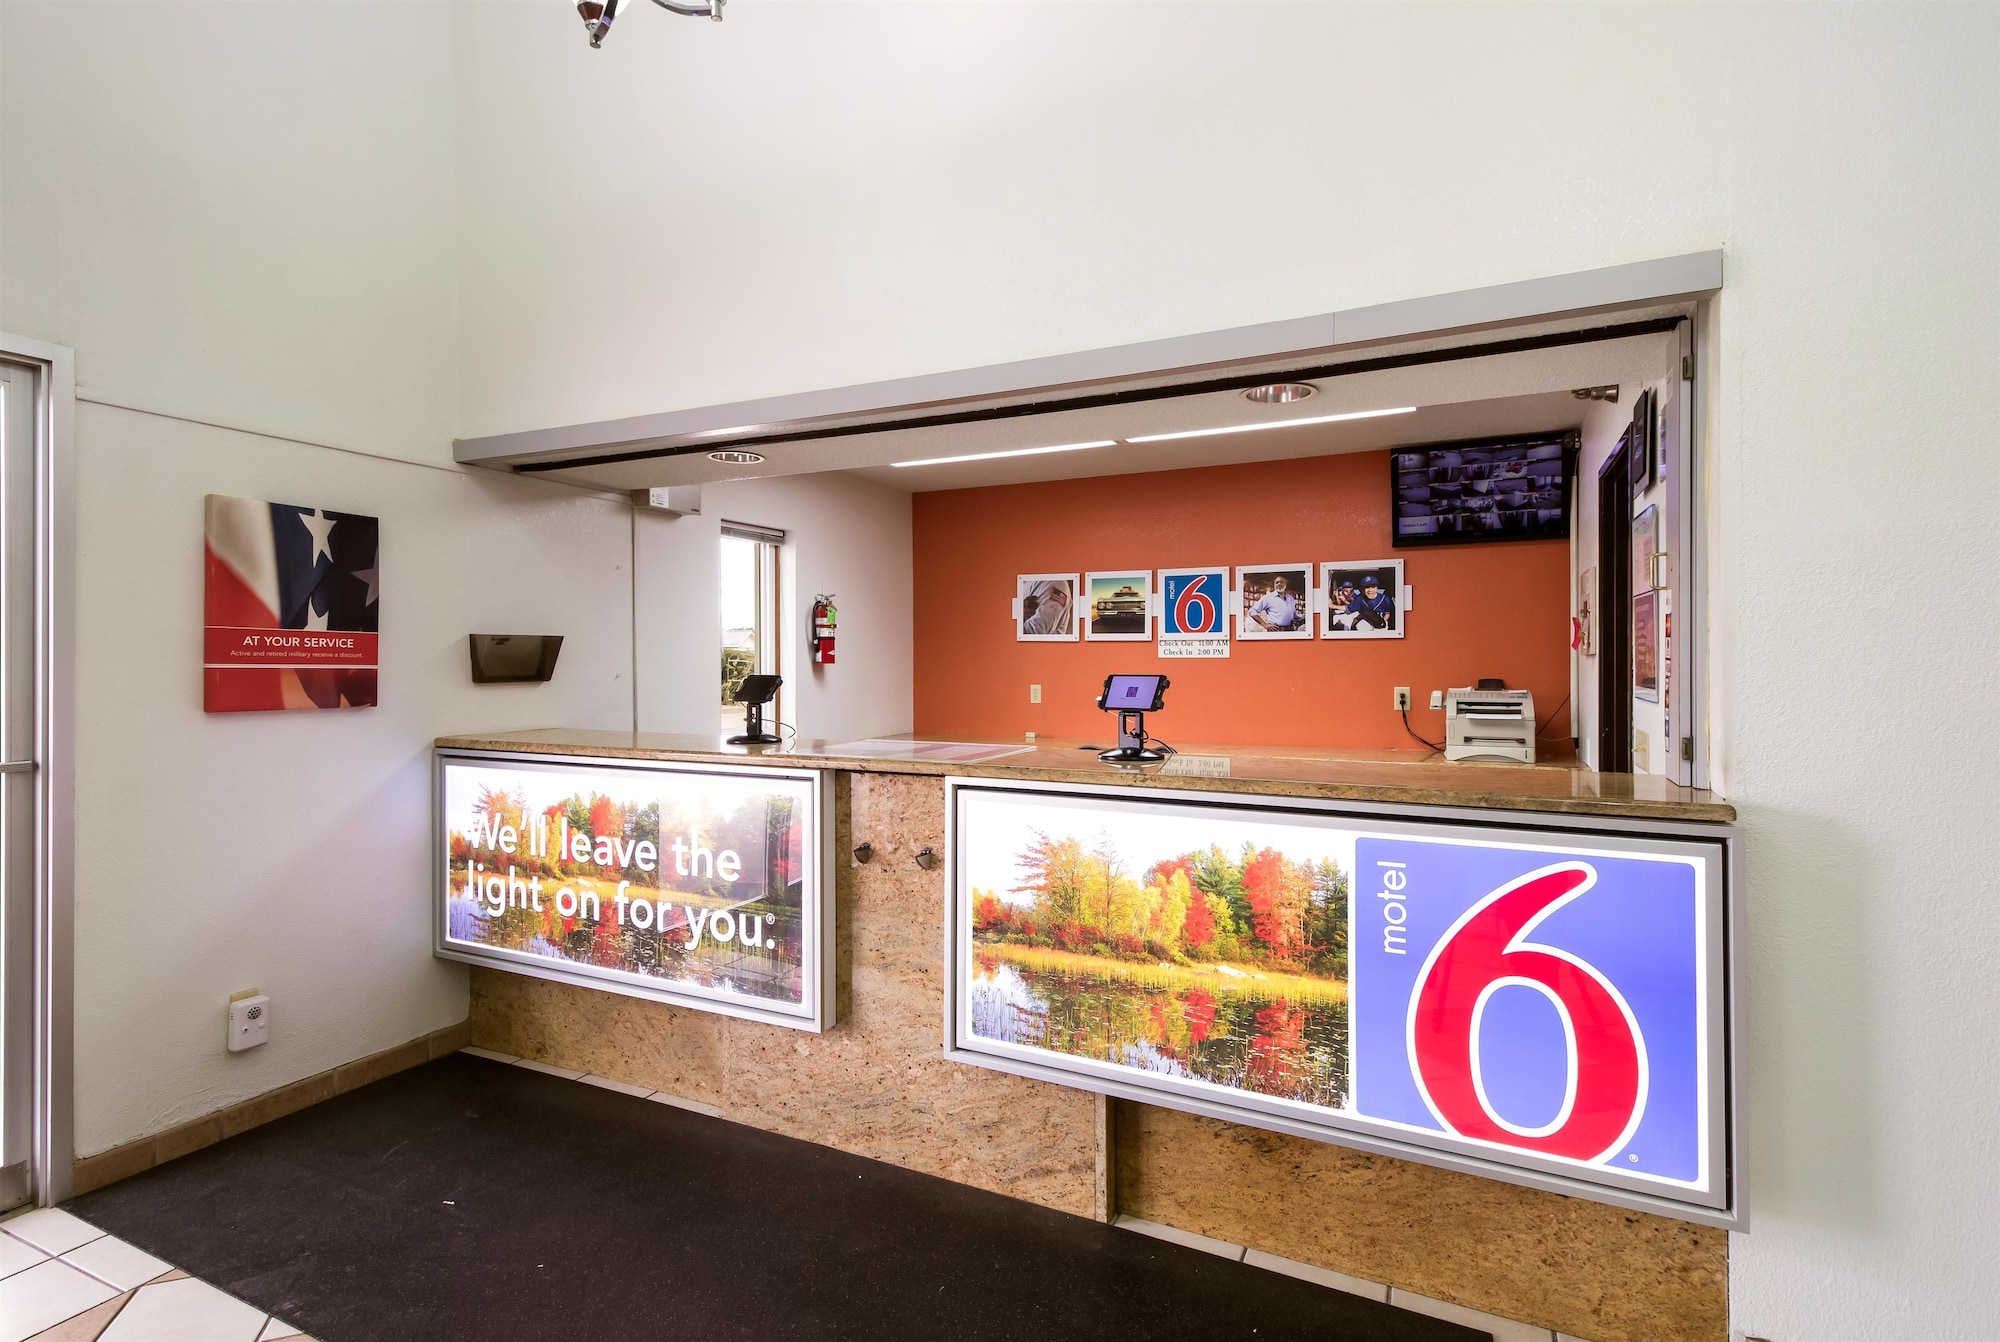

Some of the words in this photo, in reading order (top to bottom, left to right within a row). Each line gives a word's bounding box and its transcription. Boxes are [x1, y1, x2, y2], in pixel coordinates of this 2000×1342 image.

[1174, 575, 1216, 634] 6
[230, 649, 251, 657] Active
[288, 651, 311, 659] military
[242, 635, 260, 646] AT
[264, 636, 300, 647] YOUR
[304, 637, 354, 648] SERVICE
[1159, 639, 1179, 647] Check
[1181, 639, 1194, 647] Out
[1216, 639, 1229, 647] AM
[1163, 648, 1184, 656] Check
[1186, 648, 1193, 656] In
[1197, 648, 1211, 656] 2:00
[1212, 648, 1224, 656] PM
[469, 811, 547, 858] We'll
[561, 816, 657, 872] leave
[672, 826, 741, 882] the
[467, 860, 543, 918] light
[555, 886, 600, 922] on
[614, 880, 672, 932] for
[1376, 860, 1407, 955] motel
[1406, 860, 1649, 1166] 6
